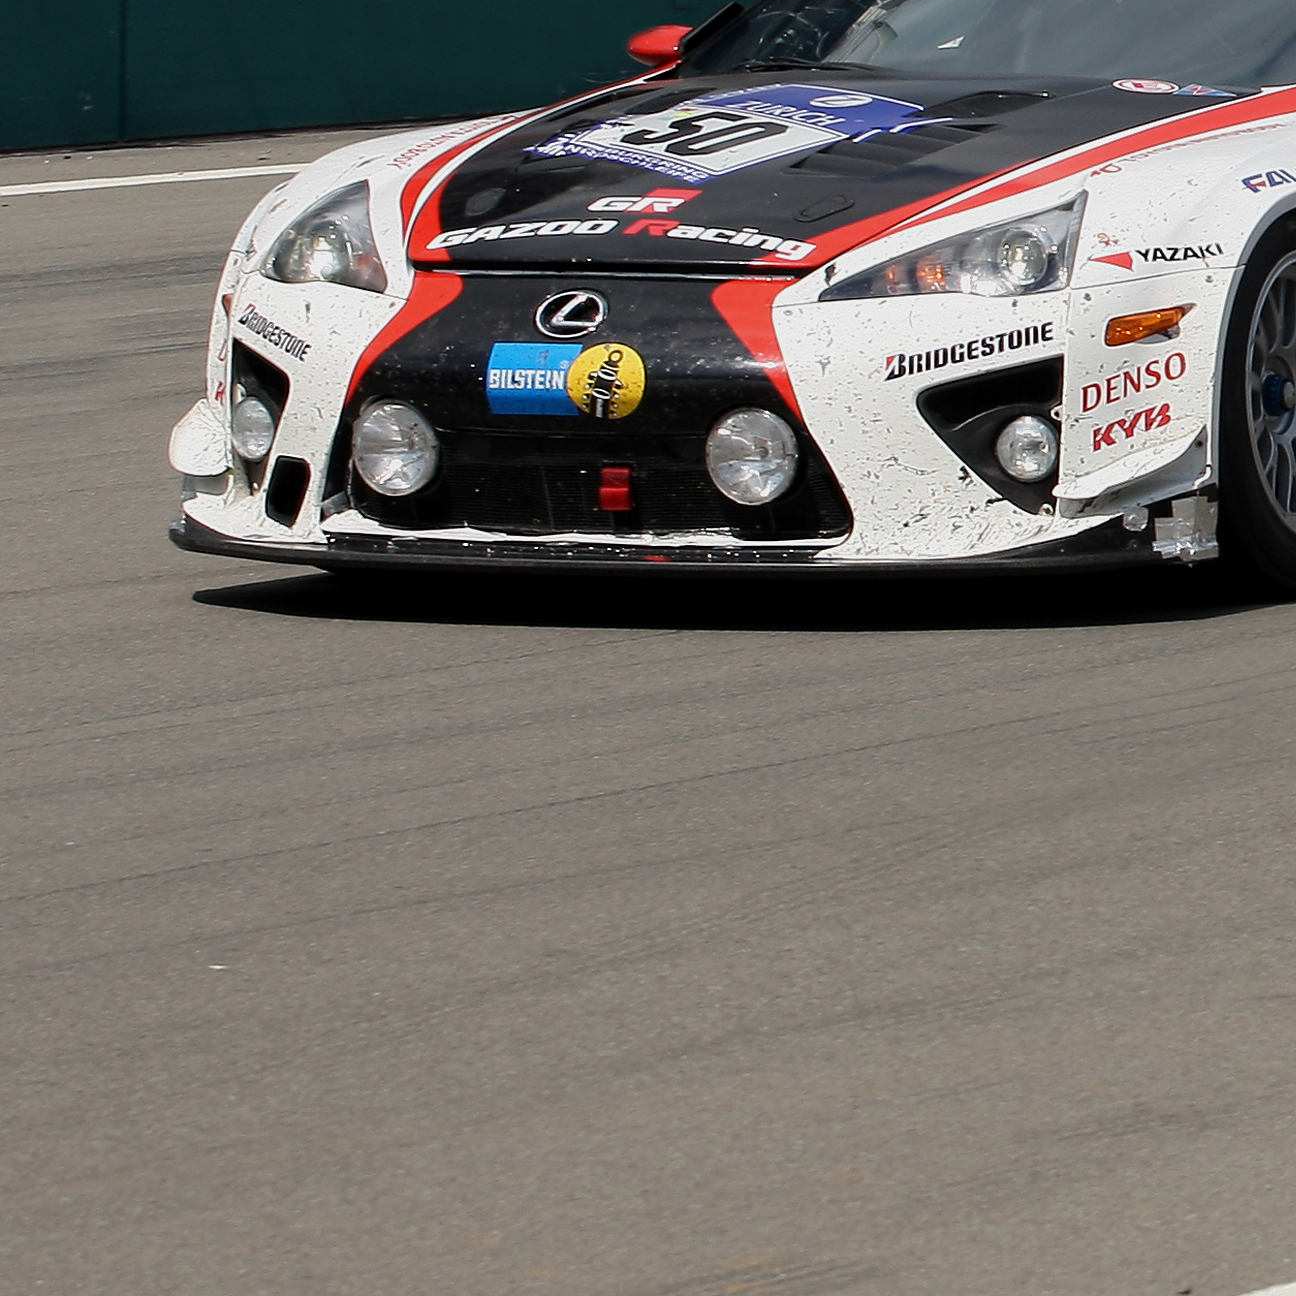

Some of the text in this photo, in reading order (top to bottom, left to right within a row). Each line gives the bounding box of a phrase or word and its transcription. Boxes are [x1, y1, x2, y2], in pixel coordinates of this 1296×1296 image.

[620, 112, 788, 157] 50
[730, 100, 846, 127] ZURICH
[587, 195, 688, 214] GR
[426, 218, 818, 261] GAZOO Racing
[1136, 242, 1225, 265] YAZAKI
[237, 304, 313, 362] BRIDGESTONE
[883, 321, 1054, 381] BRIDGESTONE
[488, 366, 566, 392] BILSTEIN
[1080, 352, 1187, 414] DENSO
[1092, 402, 1172, 453] KYB
